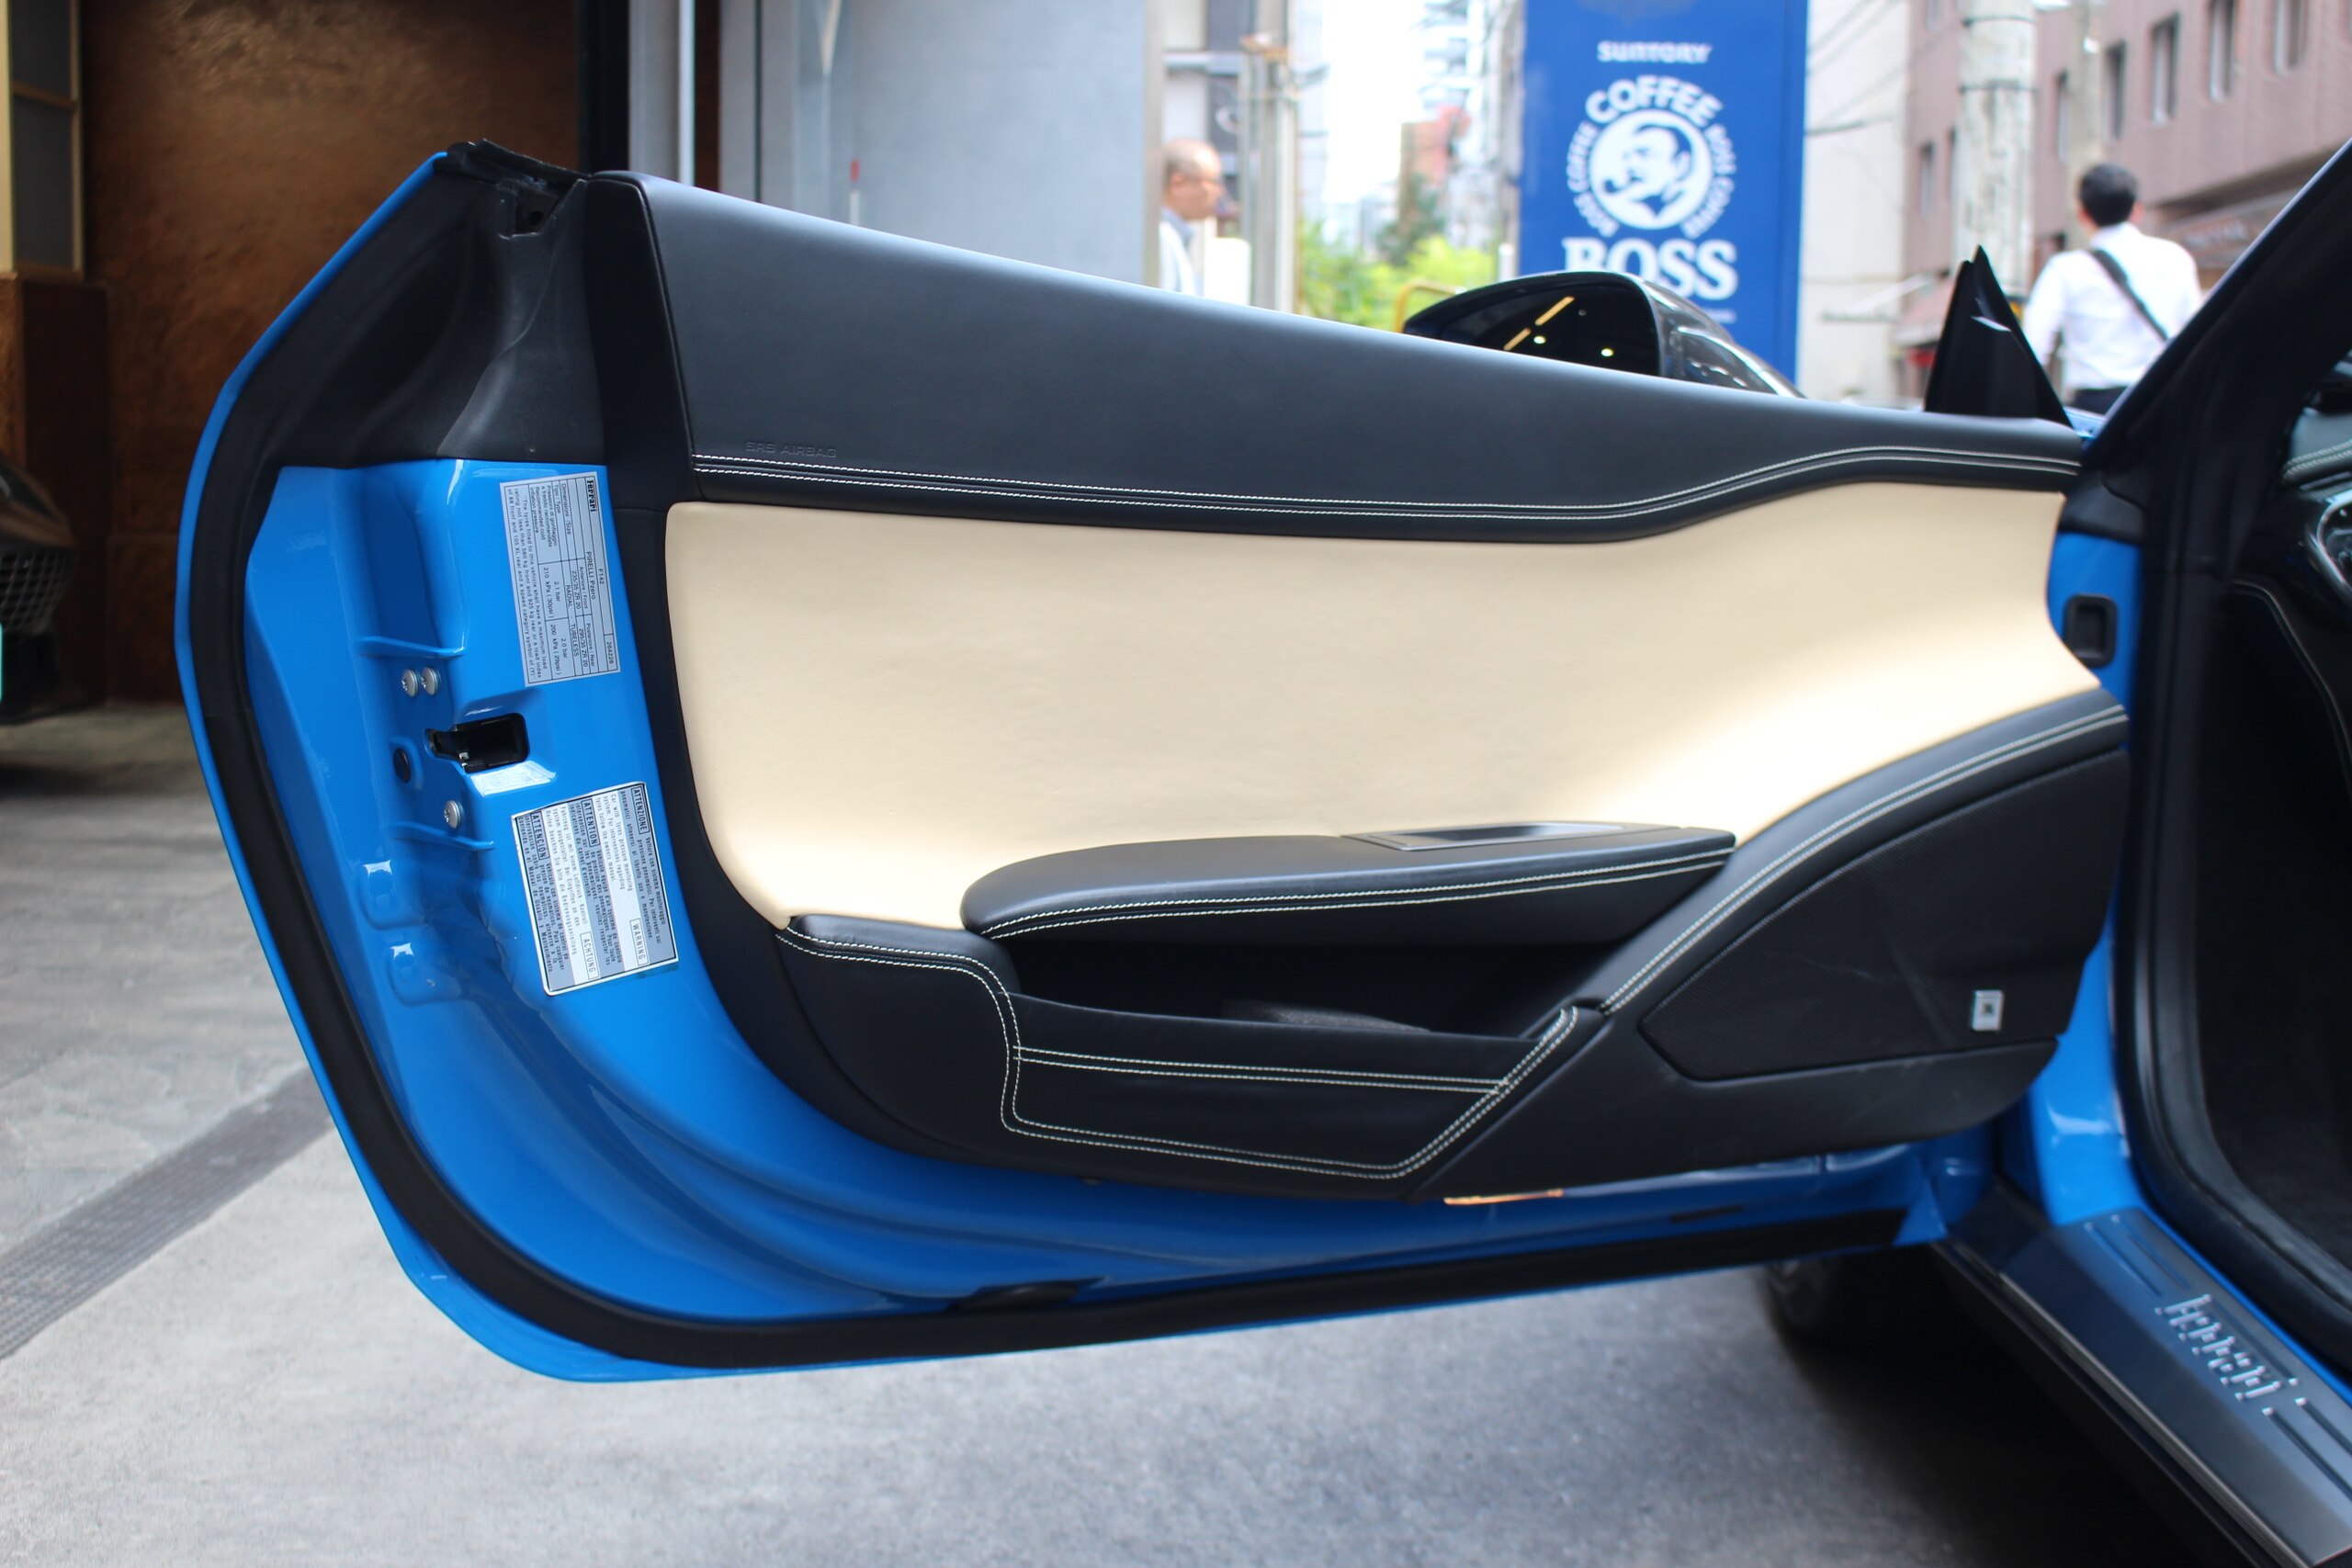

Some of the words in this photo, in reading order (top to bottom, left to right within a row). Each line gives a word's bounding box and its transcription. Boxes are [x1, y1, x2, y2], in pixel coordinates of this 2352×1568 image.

[1597, 40, 1713, 63] SUNTORY
[1585, 74, 1724, 128] COFFEE
[1561, 236, 1738, 299] BOSS
[745, 442, 776, 454] SRS
[781, 445, 838, 458] AIRBAG
[587, 479, 597, 512] Ferrari
[586, 551, 594, 578] PIRELLI
[589, 581, 597, 600] Pzero
[571, 624, 579, 657] TUBELESS
[583, 802, 598, 845] ATTENTION
[633, 789, 647, 830] ATTENZIONE
[583, 938, 596, 973] ACHTUNG
[632, 923, 645, 960] WARNING
[2154, 1293, 2290, 1400] Ferrari
